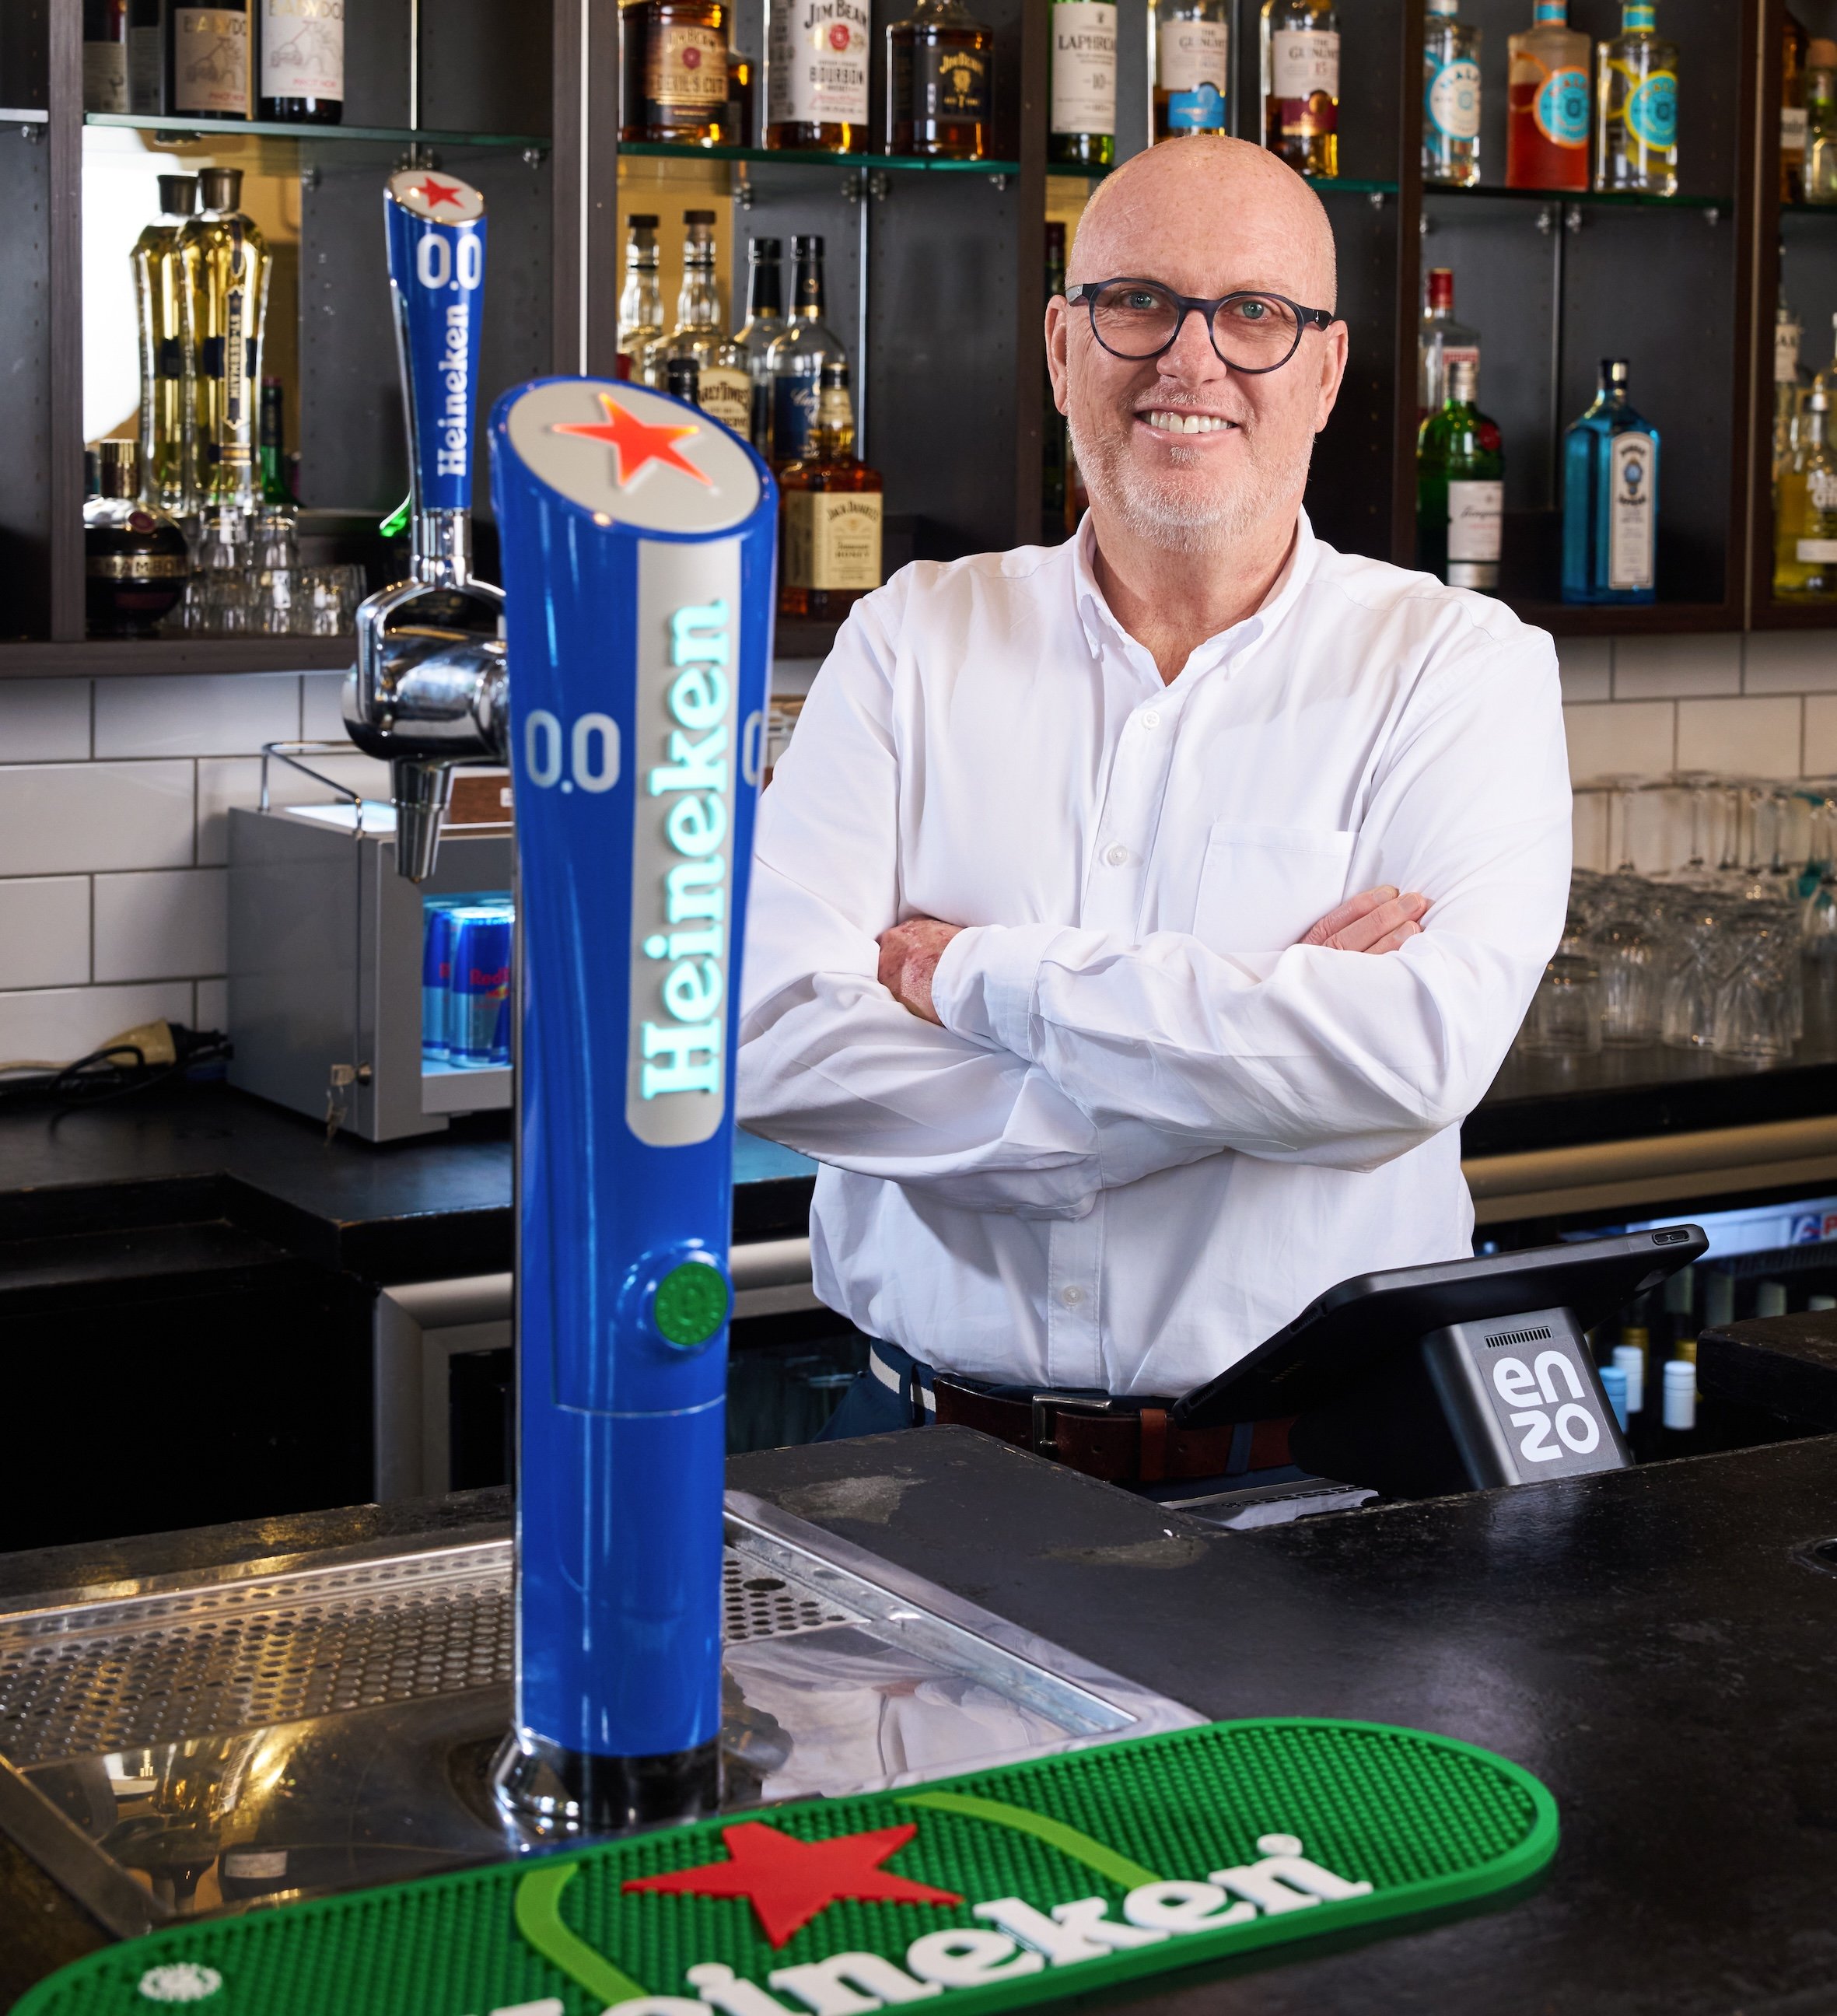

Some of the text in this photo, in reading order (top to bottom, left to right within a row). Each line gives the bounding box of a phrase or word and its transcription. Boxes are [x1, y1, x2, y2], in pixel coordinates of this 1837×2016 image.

[804, 0, 867, 30] JIM BEAM
[417, 233, 482, 292] 0.0
[437, 303, 469, 478] Heineken
[524, 709, 621, 794] 0.0
[642, 599, 729, 1100] Heineken
[459, 1854, 1373, 2016] ineken
